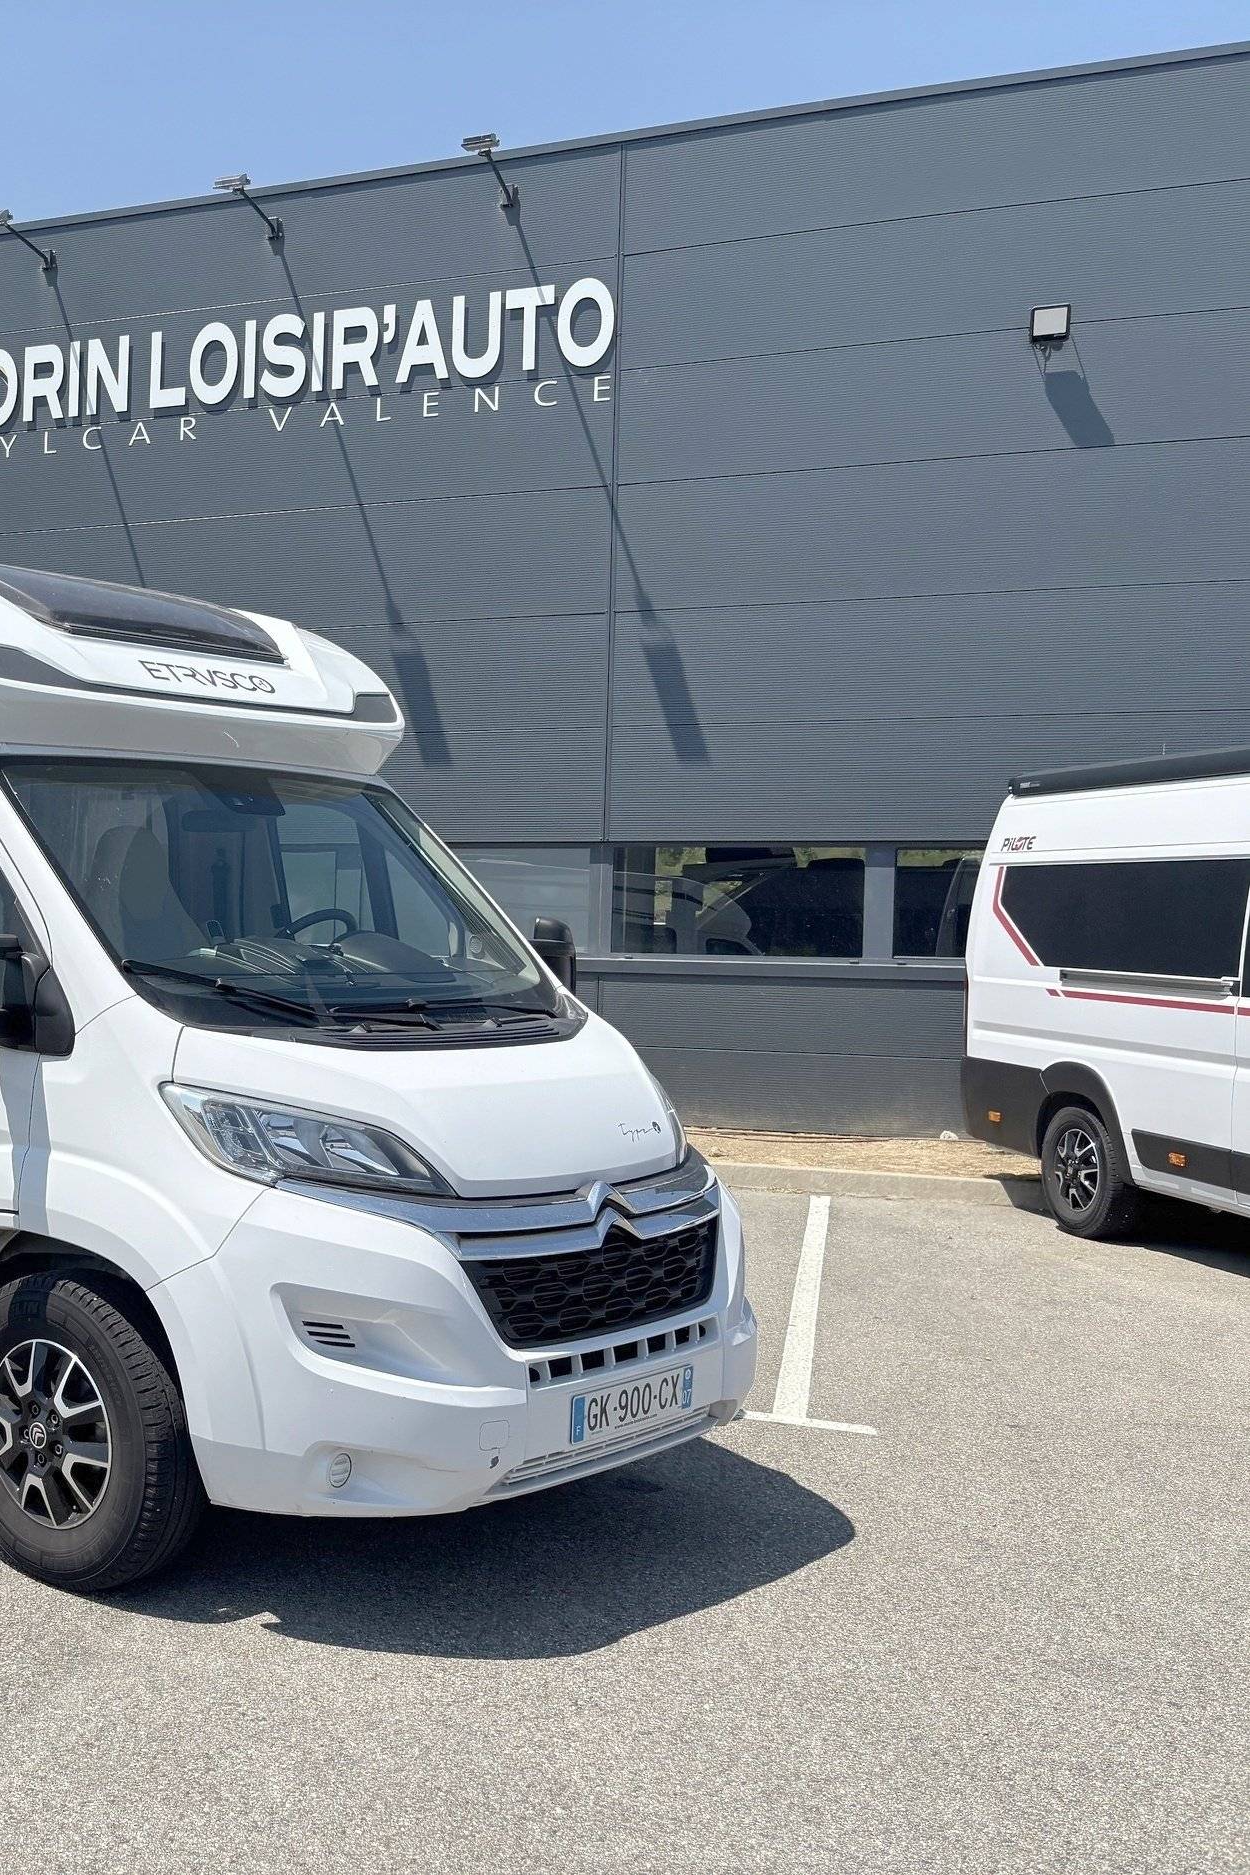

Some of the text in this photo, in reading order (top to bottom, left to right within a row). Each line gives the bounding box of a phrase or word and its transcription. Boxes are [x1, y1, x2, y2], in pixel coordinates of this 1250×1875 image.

[149, 277, 615, 409] LOISIR'AUTO
[268, 375, 611, 432] VALENCE
[587, 1373, 680, 1431] GK-900-CX
